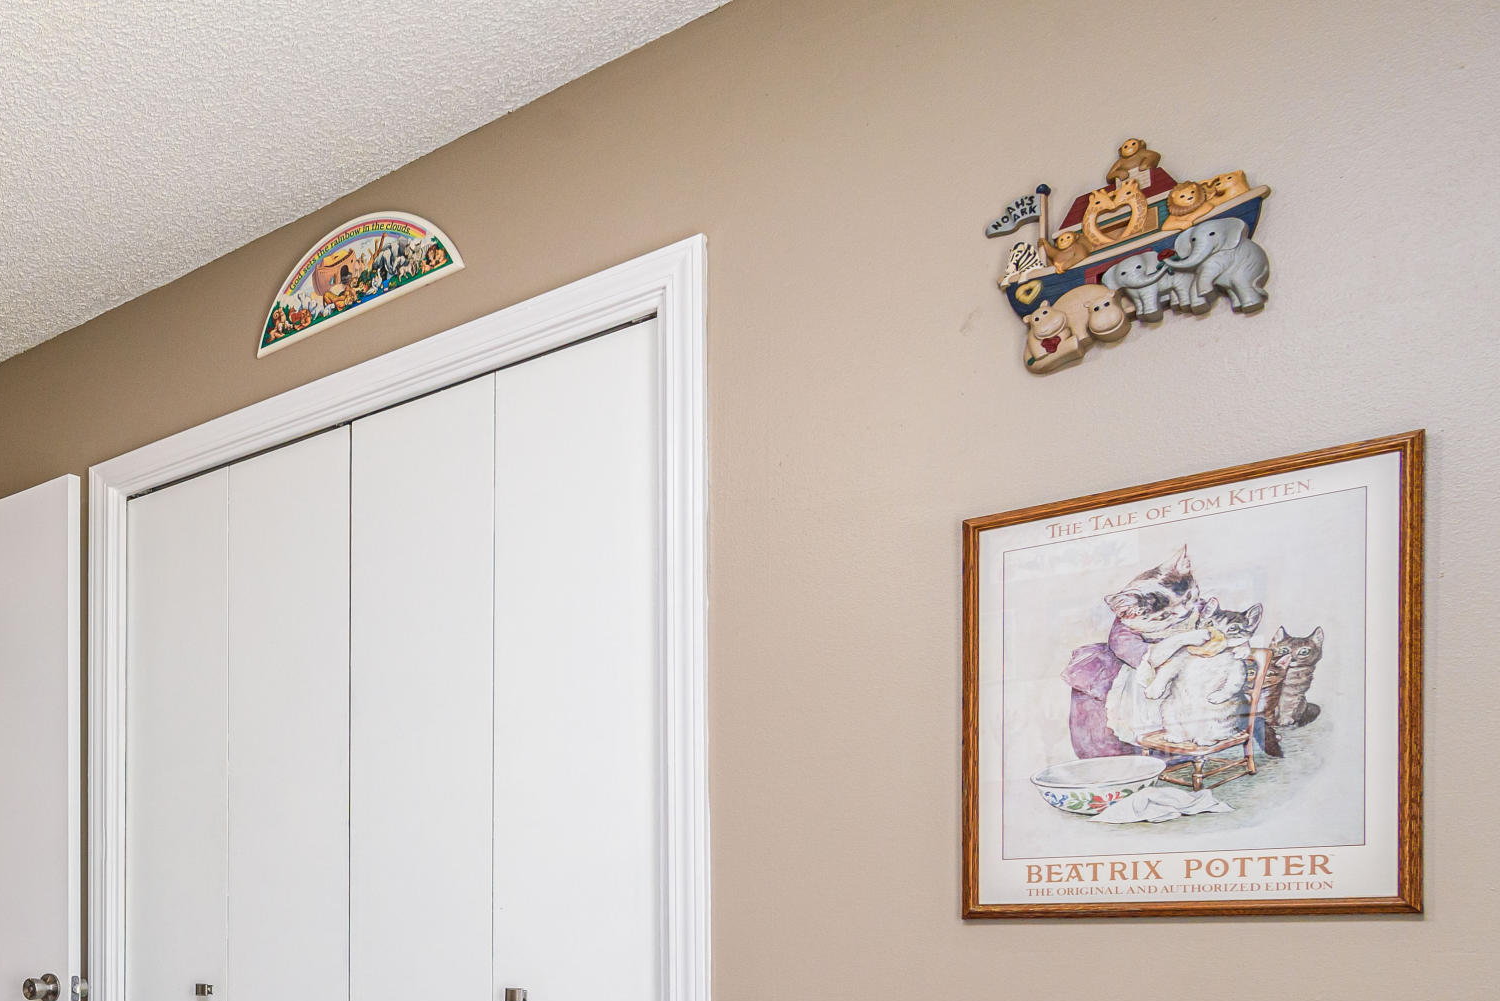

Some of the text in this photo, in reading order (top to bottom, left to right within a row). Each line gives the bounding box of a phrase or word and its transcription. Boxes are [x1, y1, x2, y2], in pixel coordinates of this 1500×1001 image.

[991, 195, 1035, 230] NOAH'S
[1013, 205, 1037, 222] ARK
[290, 222, 411, 291] God sets the rainbow in the clouds.
[1045, 479, 1312, 539] THE TALE OF TOM KITTEN
[1026, 854, 1333, 884] BEATRIX POTTER
[1026, 880, 1334, 897] THE ORIGINAL AND AUTHORIZED EDITION
